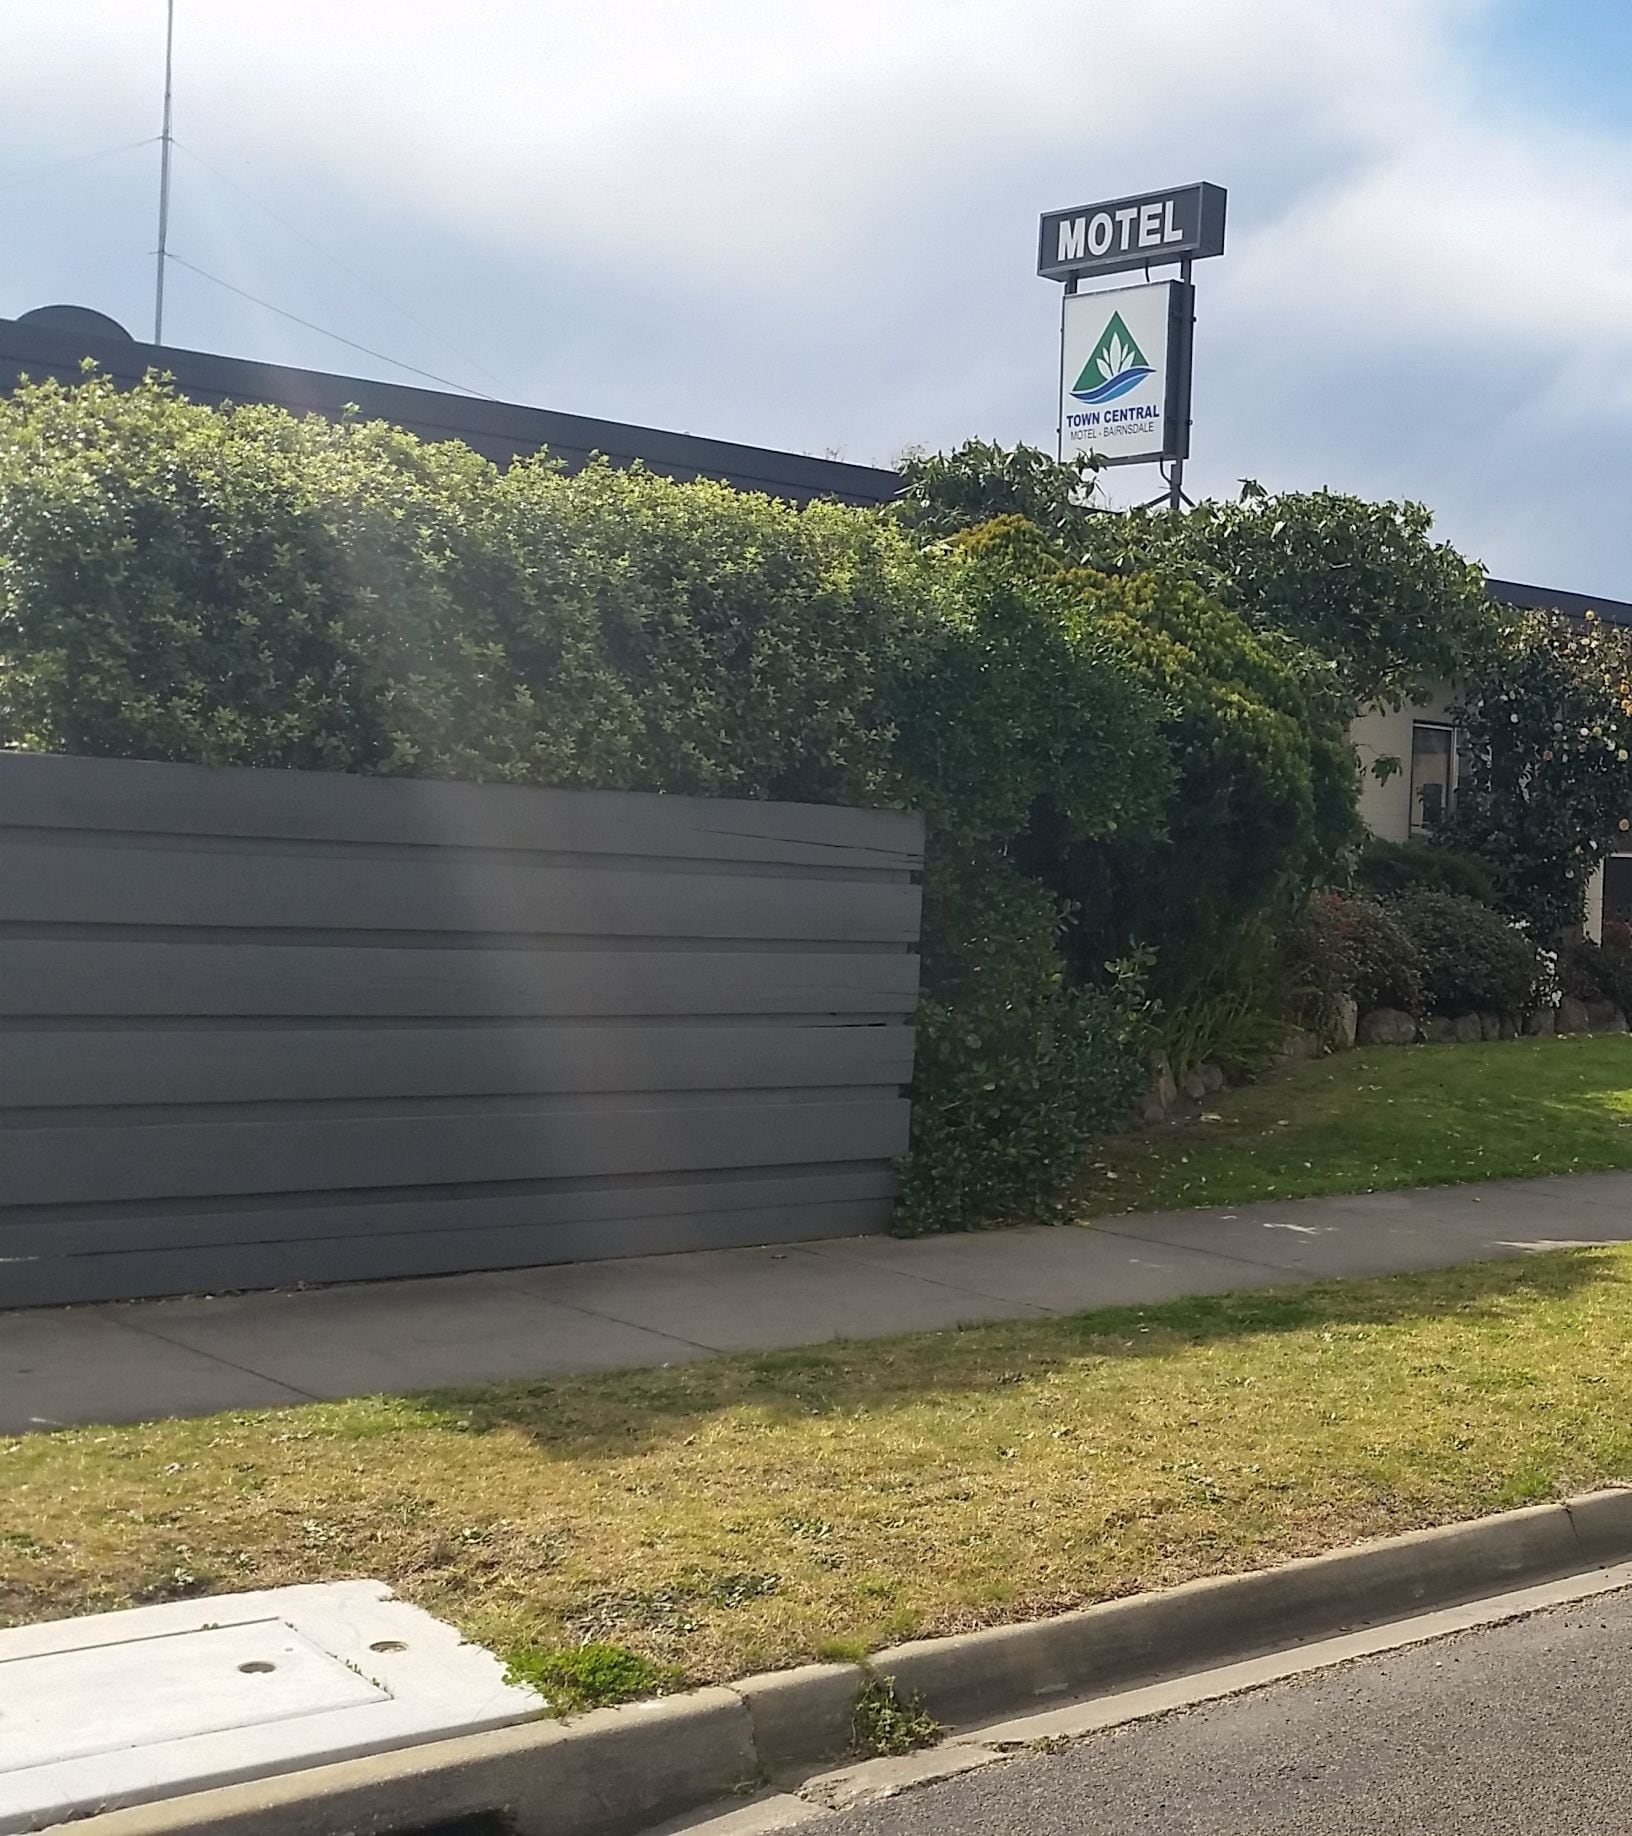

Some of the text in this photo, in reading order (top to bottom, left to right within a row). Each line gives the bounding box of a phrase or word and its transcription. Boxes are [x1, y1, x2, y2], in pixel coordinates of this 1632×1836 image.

[1057, 200, 1183, 262] MOTEL
[1066, 405, 1160, 428] TOWN CENTRAL
[1070, 429, 1097, 441] MOTEL
[1103, 421, 1155, 438] BAIRNSDALE
